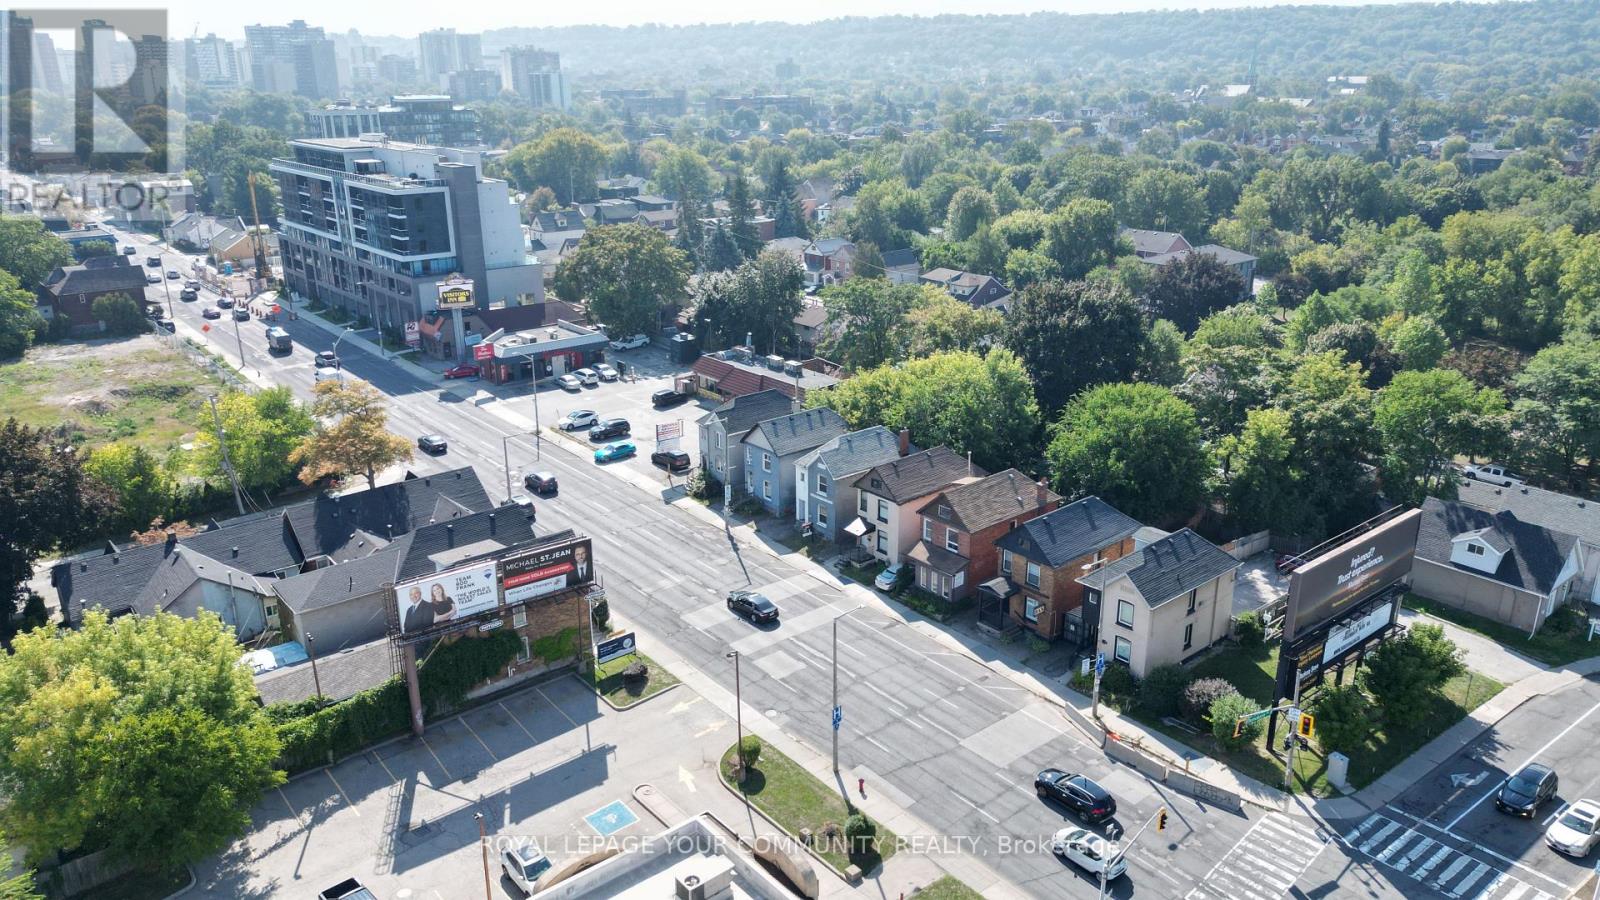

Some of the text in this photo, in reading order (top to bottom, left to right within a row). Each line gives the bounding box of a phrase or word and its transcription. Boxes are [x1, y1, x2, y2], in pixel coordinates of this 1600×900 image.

[1350, 546, 1376, 568] Injured?
[506, 558, 539, 571] MICHAEL
[1337, 569, 1352, 585] Trust
[456, 583, 475, 591] FRANK
[1097, 653, 1104, 665] H
[833, 707, 841, 719] H
